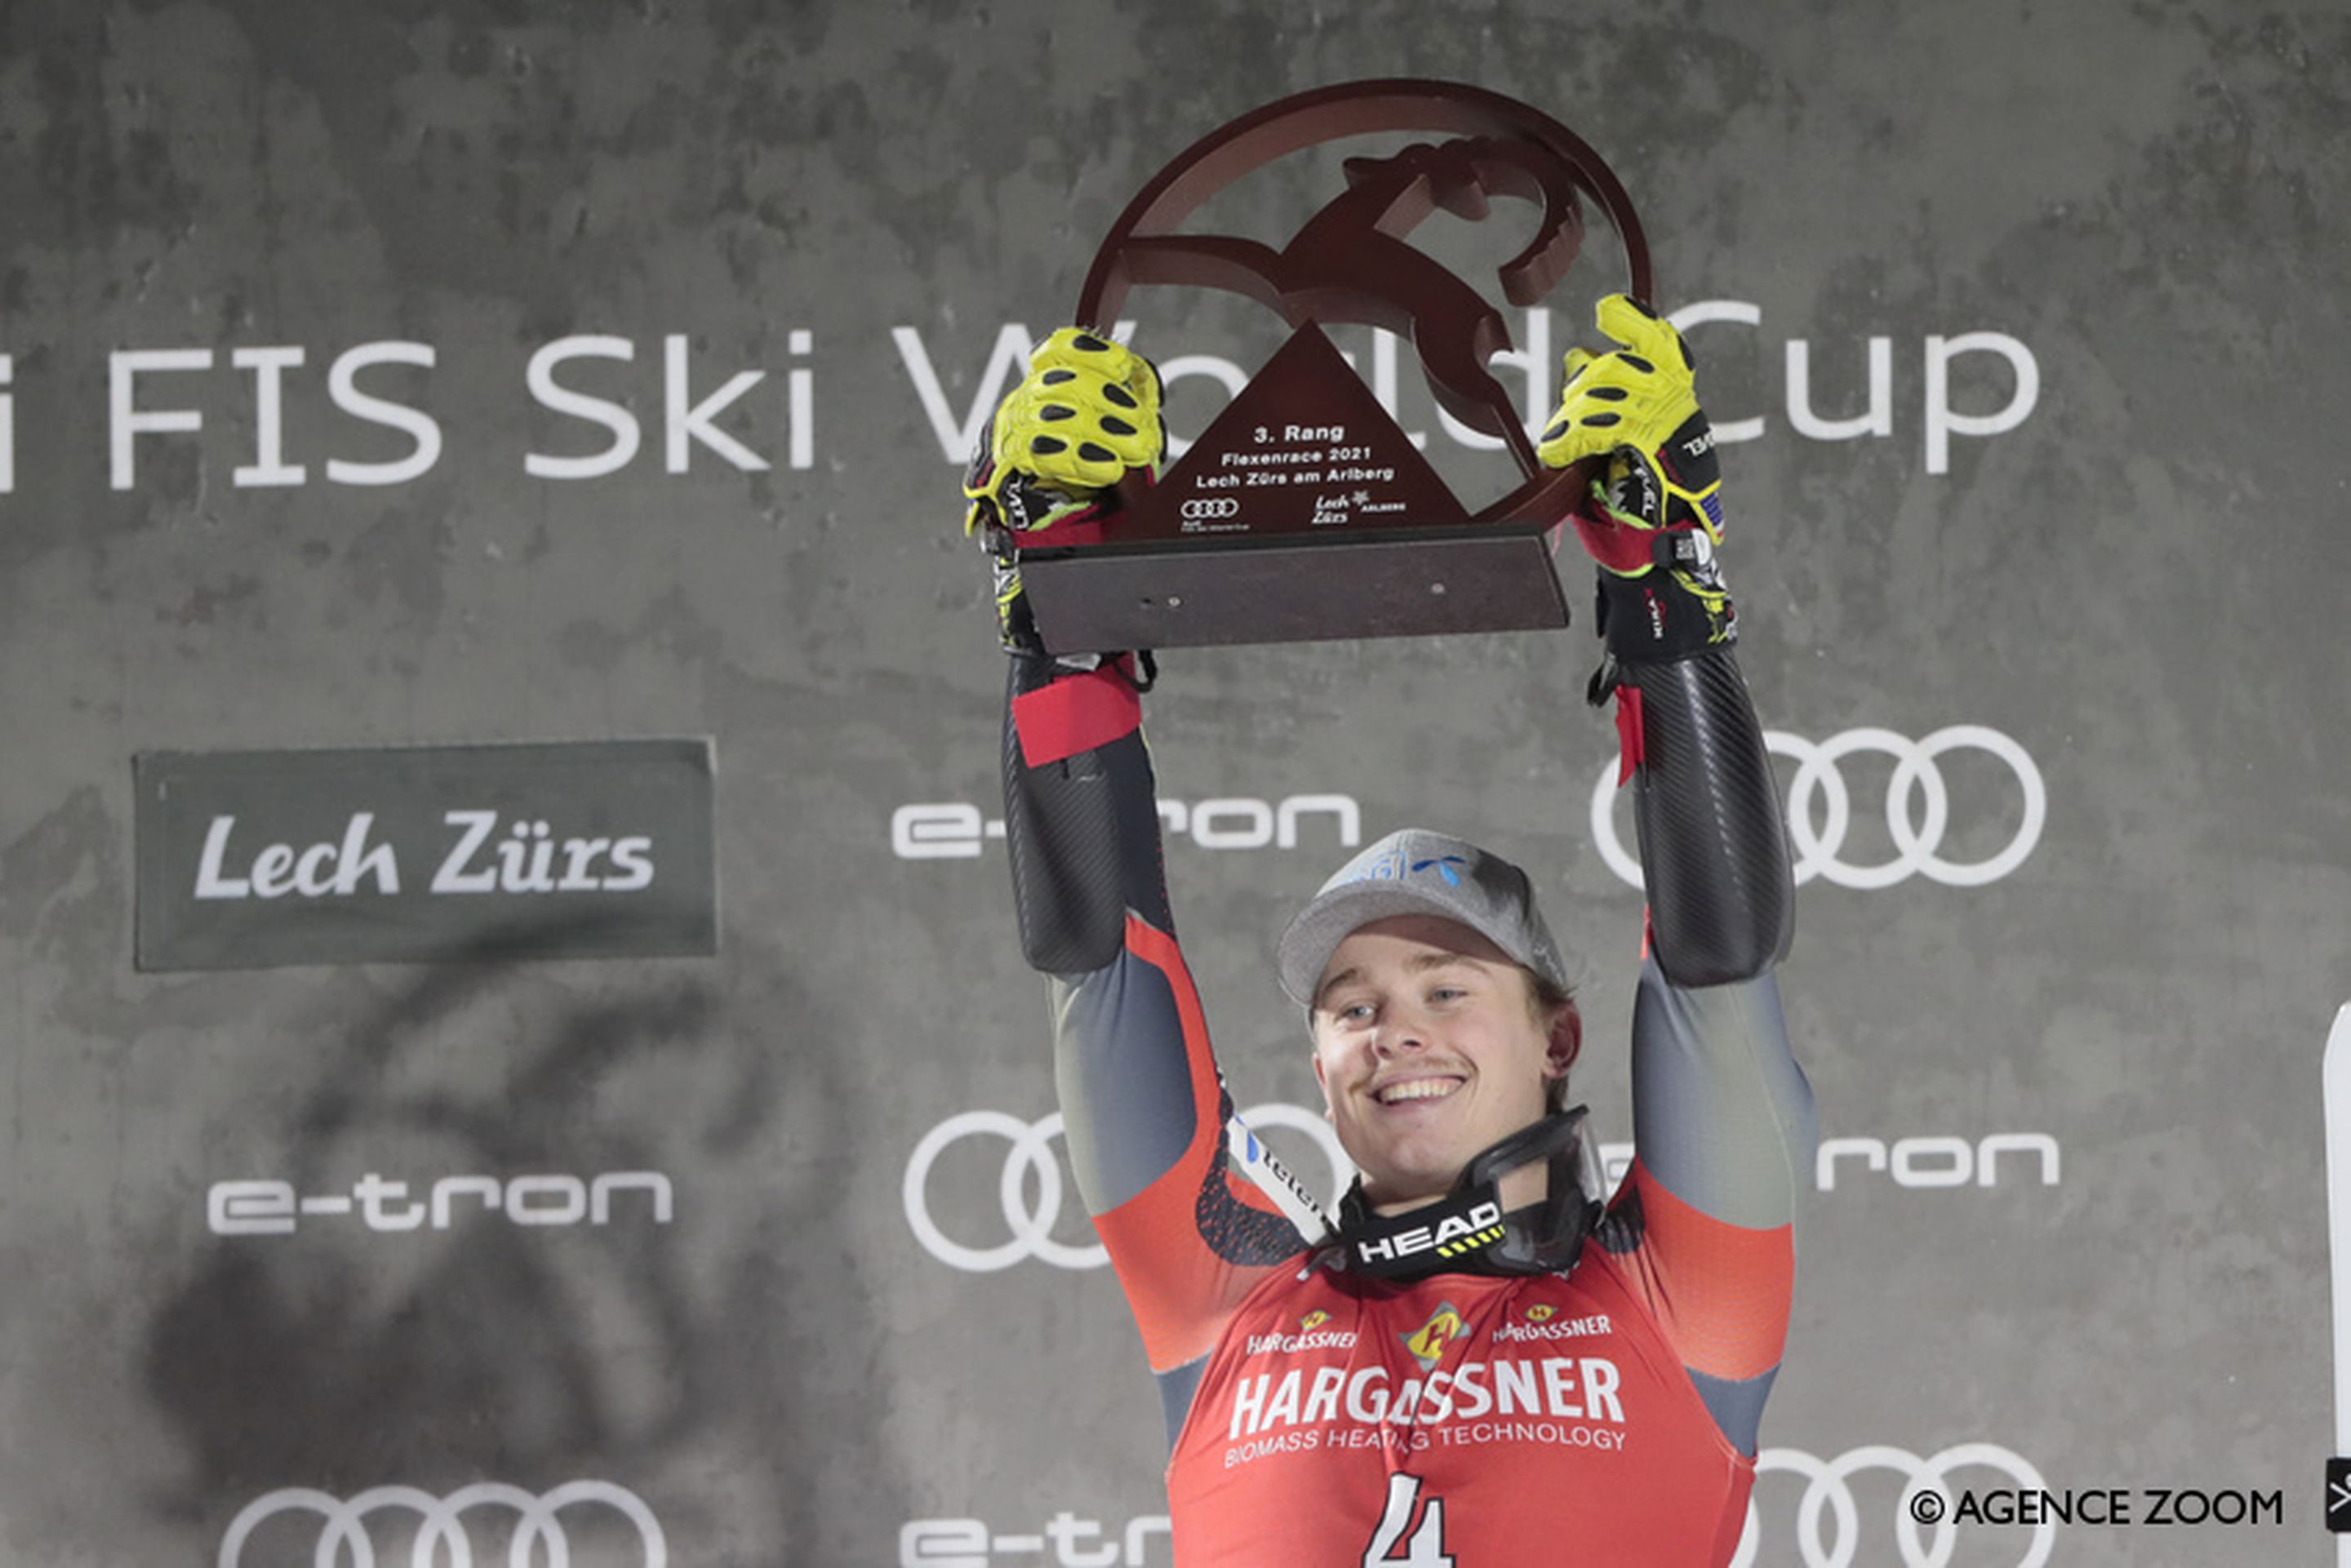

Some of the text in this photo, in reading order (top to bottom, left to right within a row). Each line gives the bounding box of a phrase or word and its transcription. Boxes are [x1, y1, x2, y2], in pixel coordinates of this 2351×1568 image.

[110, 341, 442, 490] FIS
[525, 330, 813, 478] Ski
[891, 307, 1550, 464] Wold
[1667, 300, 2039, 473] Cup
[1221, 446, 1371, 466] Flexenrace 2021
[1254, 425, 1345, 443] 3. Rang
[1196, 474, 1240, 488] Lech
[1294, 473, 1320, 483] am
[1327, 468, 1394, 482] Arlberg
[1316, 495, 1349, 509] Lech
[195, 811, 654, 898] Lech Zürs
[892, 794, 1360, 858] e-on
[208, 1172, 672, 1233] e-tron
[1358, 1202, 1500, 1262] HEAD
[1493, 1315, 1611, 1343] HARGASSNER
[1229, 1357, 1624, 1441] HARGASSNER
[1224, 1429, 1320, 1468] BIOMASS
[1439, 1423, 1626, 1450] TECHNOLOGY
[900, 1512, 1173, 1568] e-tr
[1362, 1472, 1455, 1568] 4
